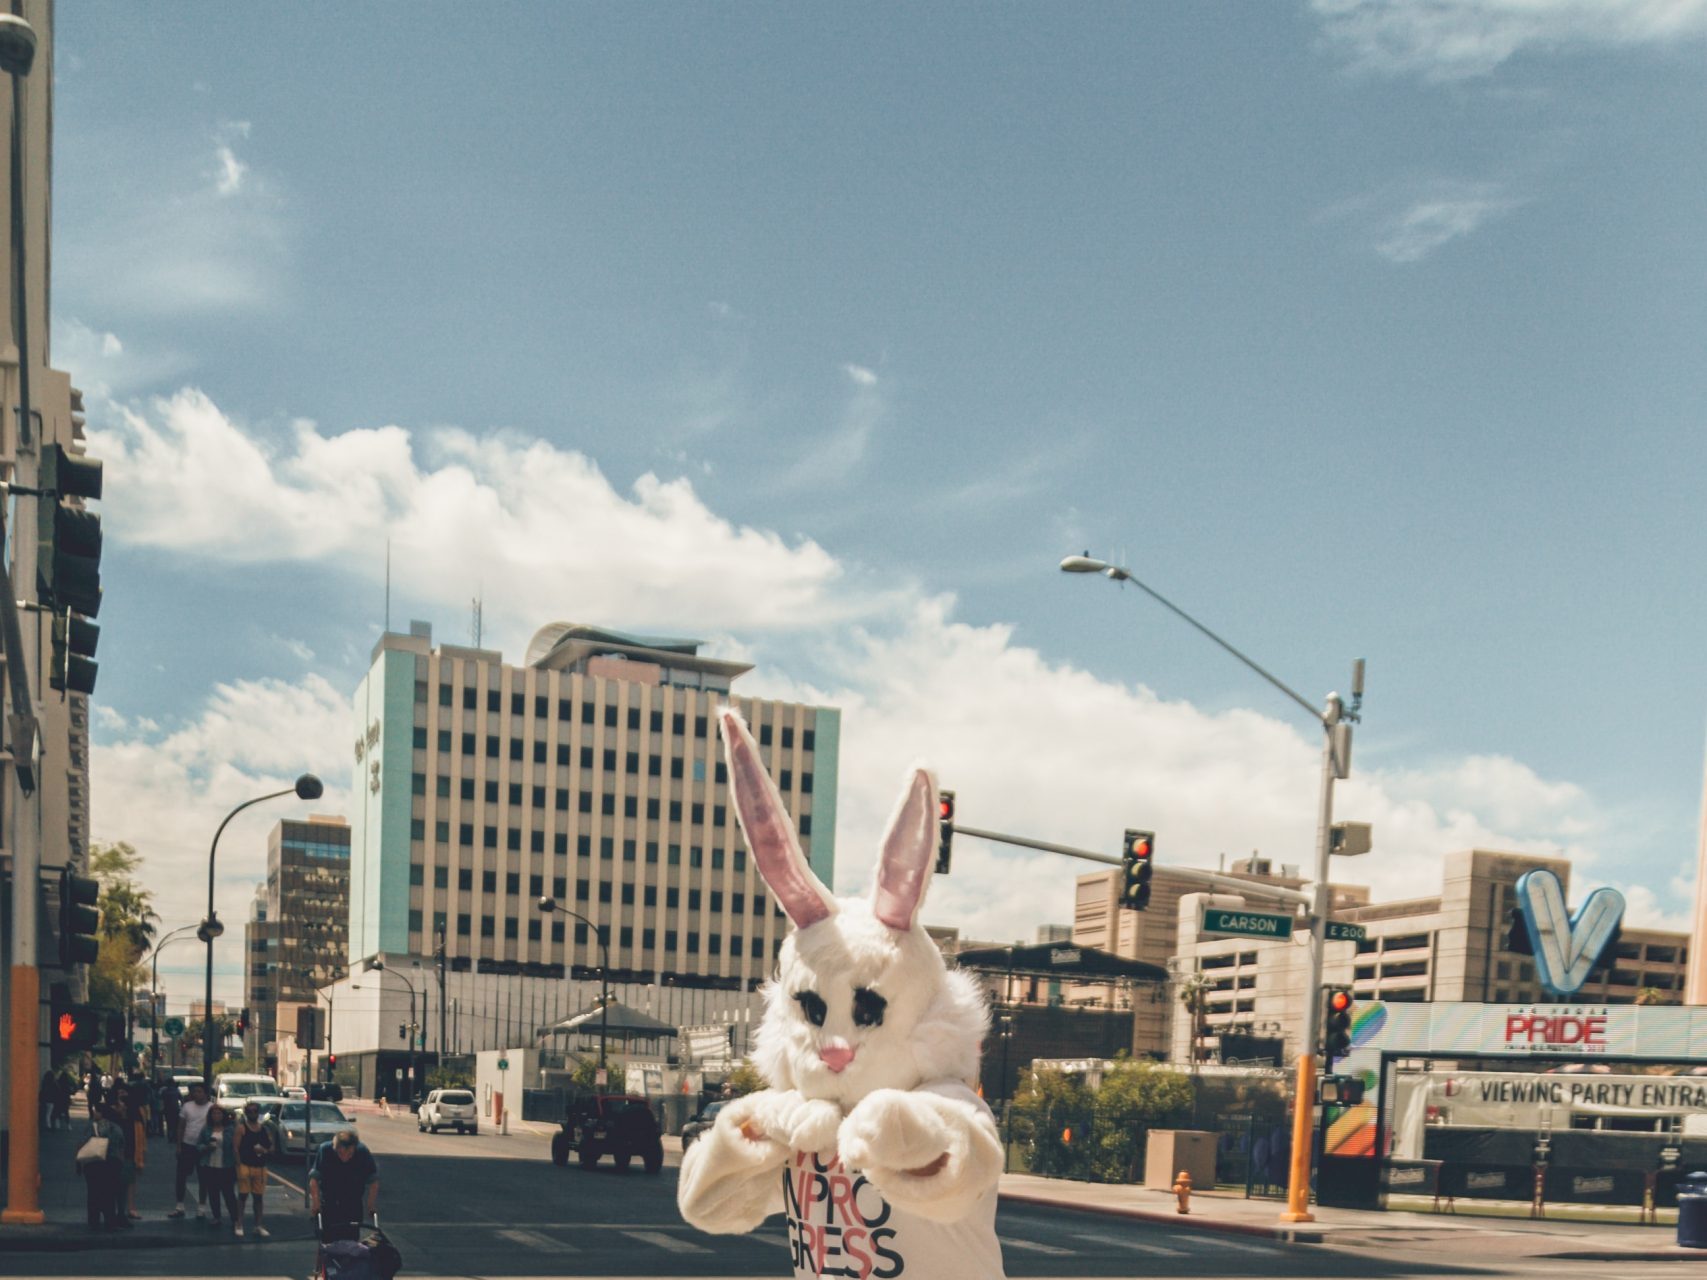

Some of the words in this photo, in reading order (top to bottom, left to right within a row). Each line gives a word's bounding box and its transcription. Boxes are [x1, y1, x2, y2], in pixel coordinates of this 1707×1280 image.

[1219, 914, 1277, 932] CARSON
[1330, 925, 1337, 936] E
[1341, 926, 1366, 938] 200
[1505, 1014, 1607, 1044] PRIDE
[1481, 1079, 1563, 1103] VIEWING
[1570, 1082, 1634, 1106] PARTY
